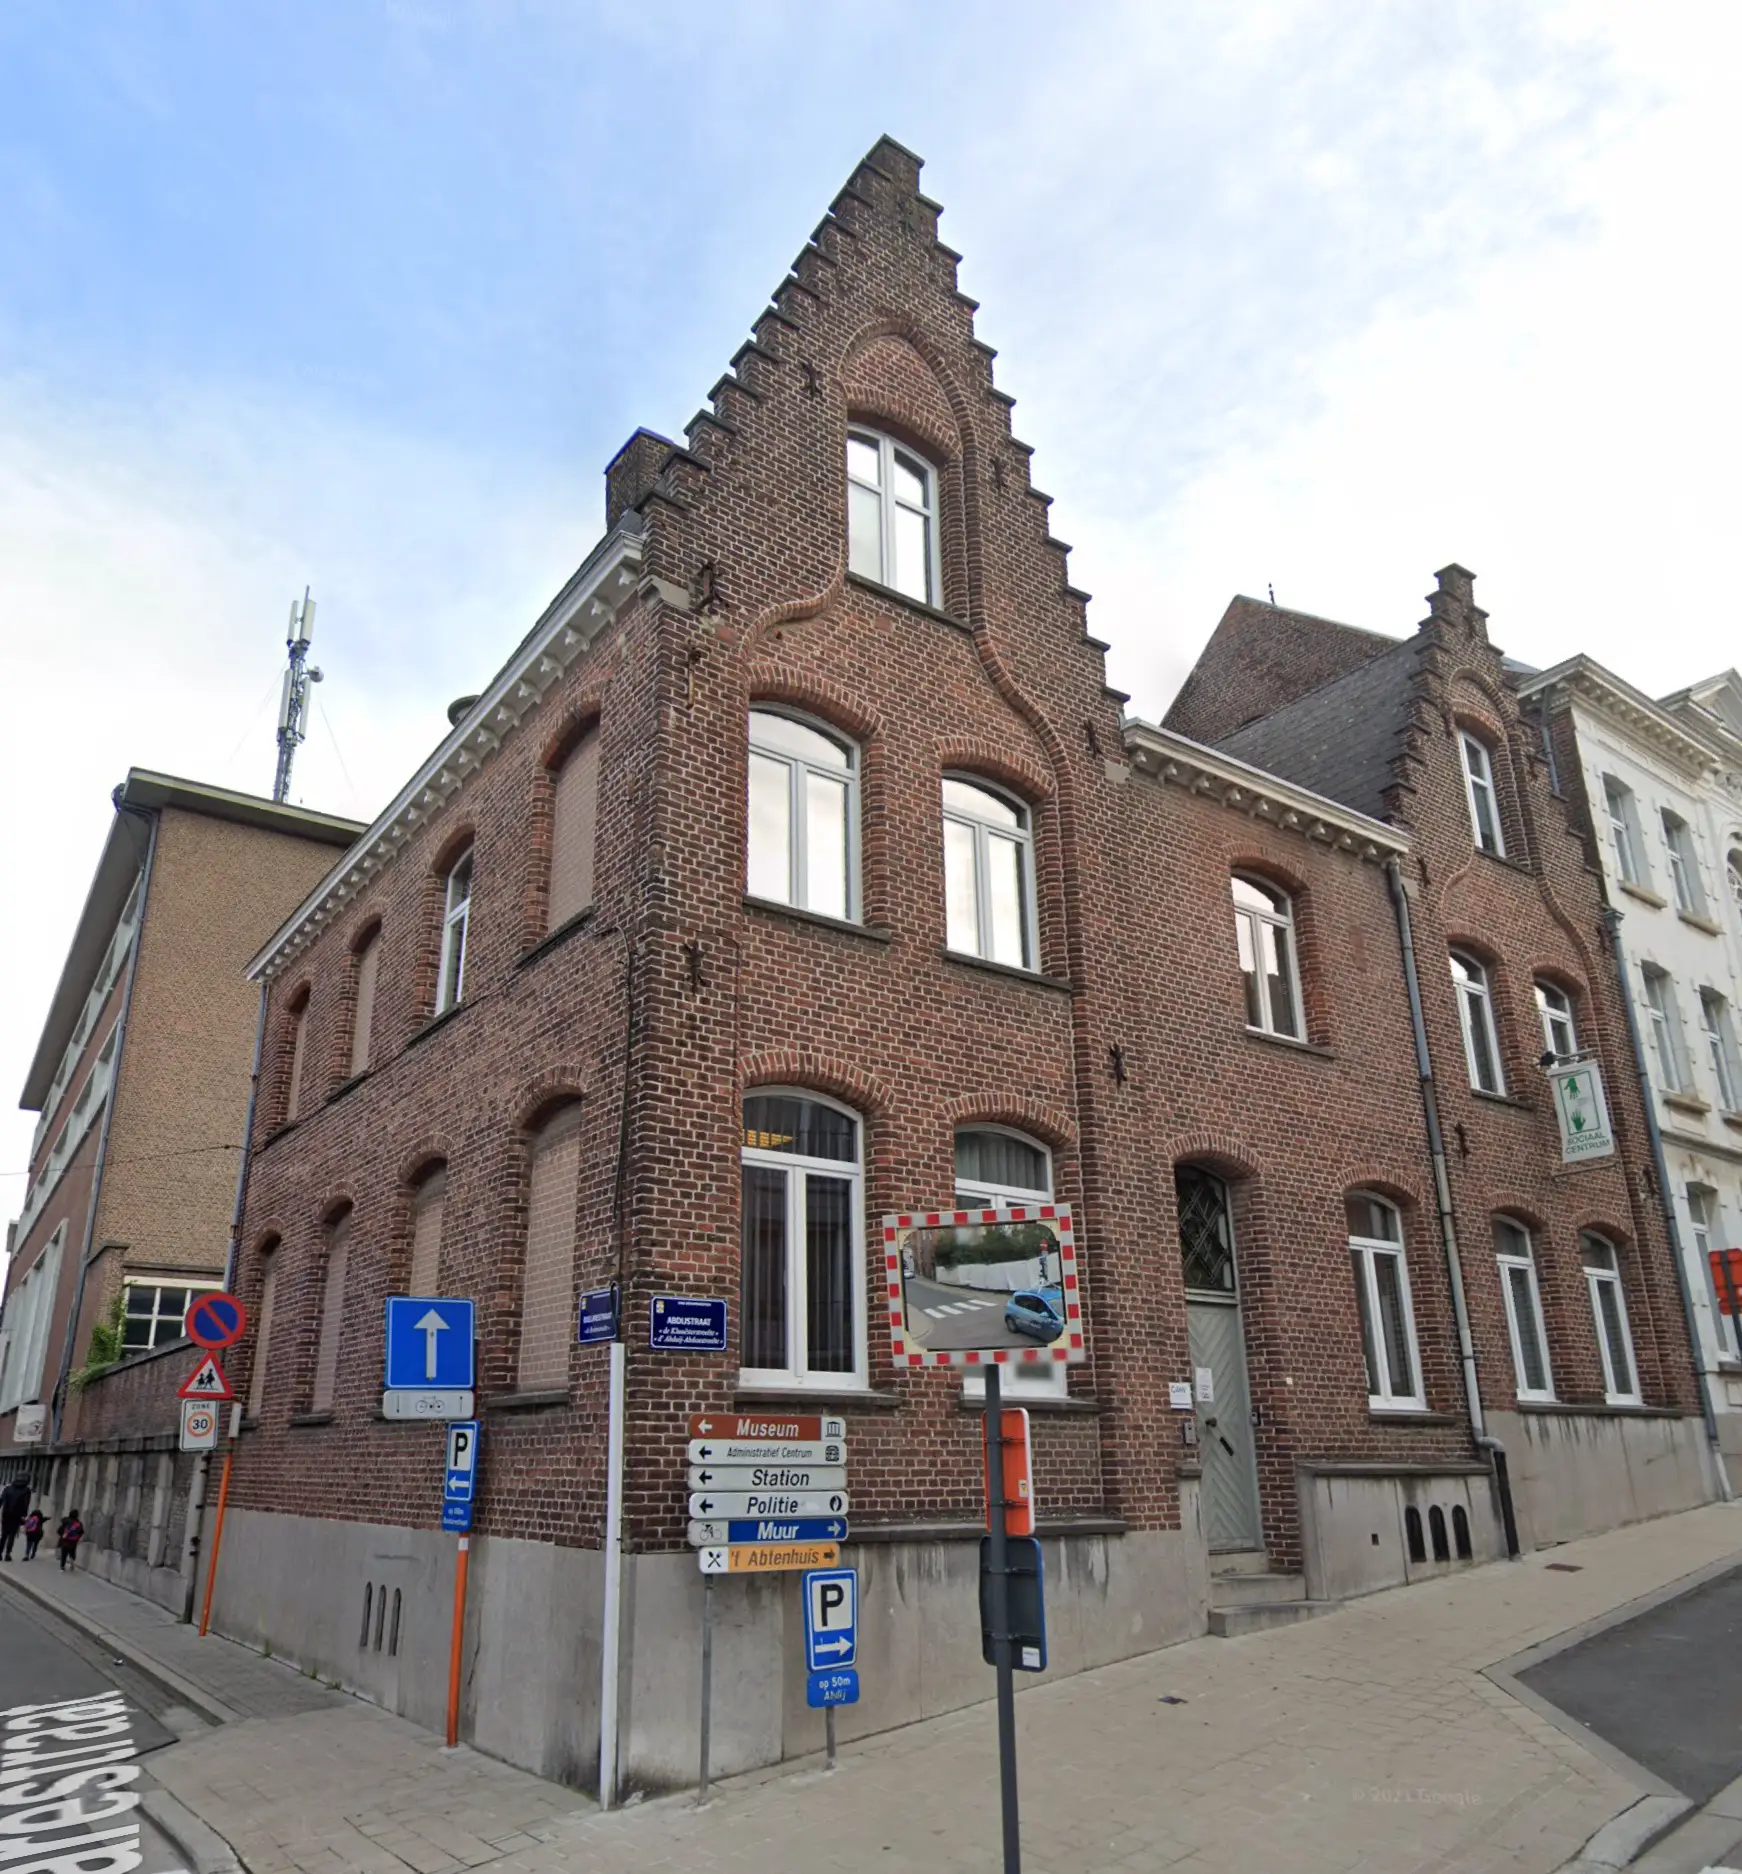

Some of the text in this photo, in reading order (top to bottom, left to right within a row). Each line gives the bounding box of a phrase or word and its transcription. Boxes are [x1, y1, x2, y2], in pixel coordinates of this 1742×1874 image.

[1566, 1139, 1610, 1154] CENTRUM
[1568, 1132, 1606, 1145] SOCIAAL
[666, 1316, 712, 1326] ABDIJSTRAAT
[192, 1418, 209, 1430] 30
[736, 1418, 799, 1437] Museum
[453, 1432, 469, 1467] P
[727, 1446, 813, 1458] Administratief Centrum
[751, 1468, 810, 1487] Station
[746, 1496, 799, 1515] Politie
[757, 1521, 800, 1540] Muur
[747, 1548, 820, 1567] Abtenhuis
[820, 1583, 845, 1627] P
[818, 1680, 830, 1691] op
